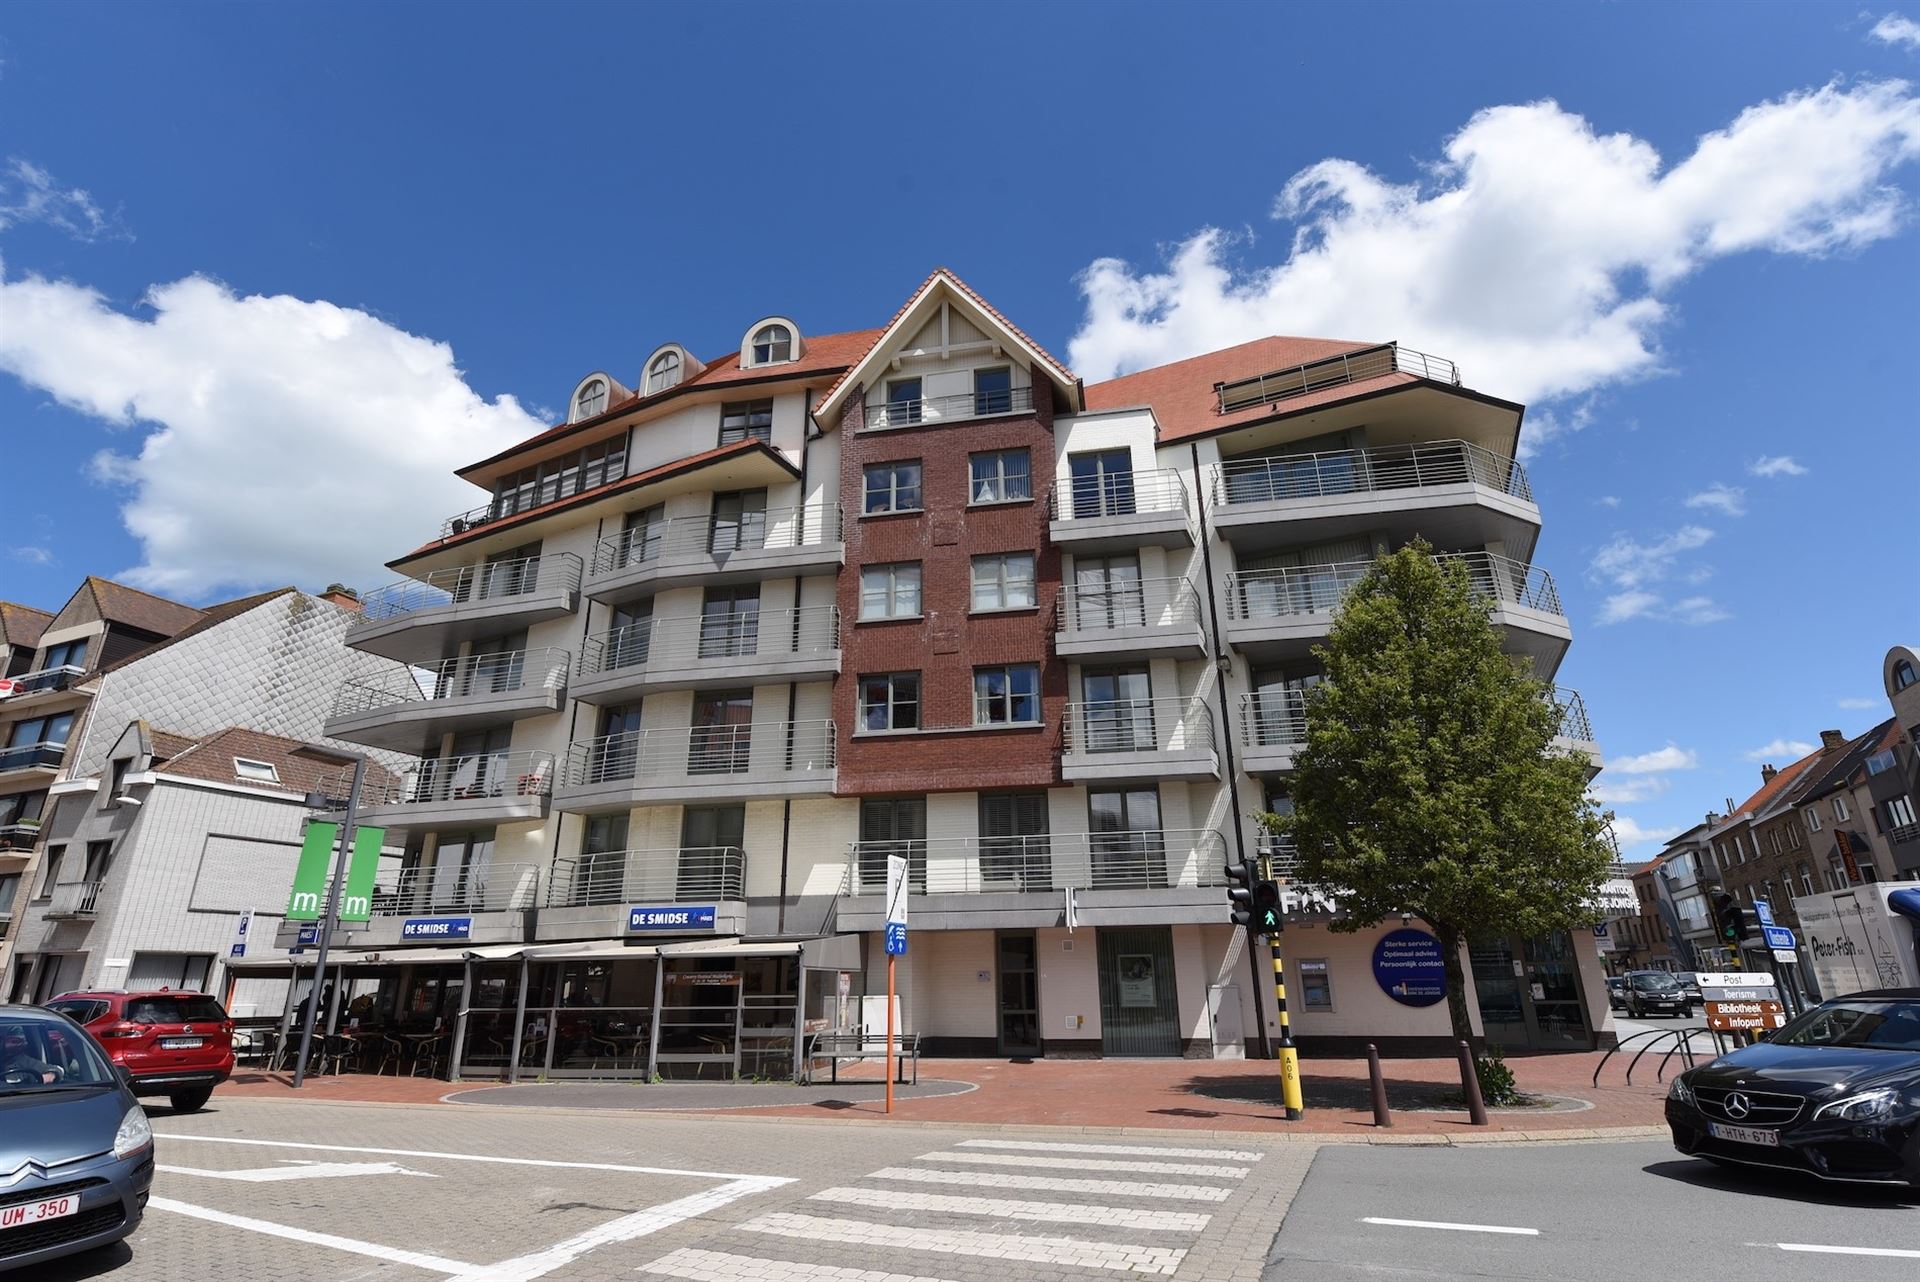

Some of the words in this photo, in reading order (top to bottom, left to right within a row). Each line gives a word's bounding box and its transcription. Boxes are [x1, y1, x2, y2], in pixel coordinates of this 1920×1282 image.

[1610, 898, 1641, 909] JONGHE
[632, 914, 646, 925] DE
[647, 913, 689, 924] SMIDSE
[404, 924, 416, 934] DE
[416, 923, 450, 934] SMIDSE
[1811, 935, 1857, 961] Peter-Fish
[1383, 951, 1414, 959] Optimaal
[1723, 975, 1743, 985] Post
[1723, 989, 1757, 999] Toerisme
[1717, 1003, 1762, 1014] Bibliotheek
[1728, 1016, 1765, 1029] Infopunt
[1713, 1124, 1777, 1145] 1-HTH-673
